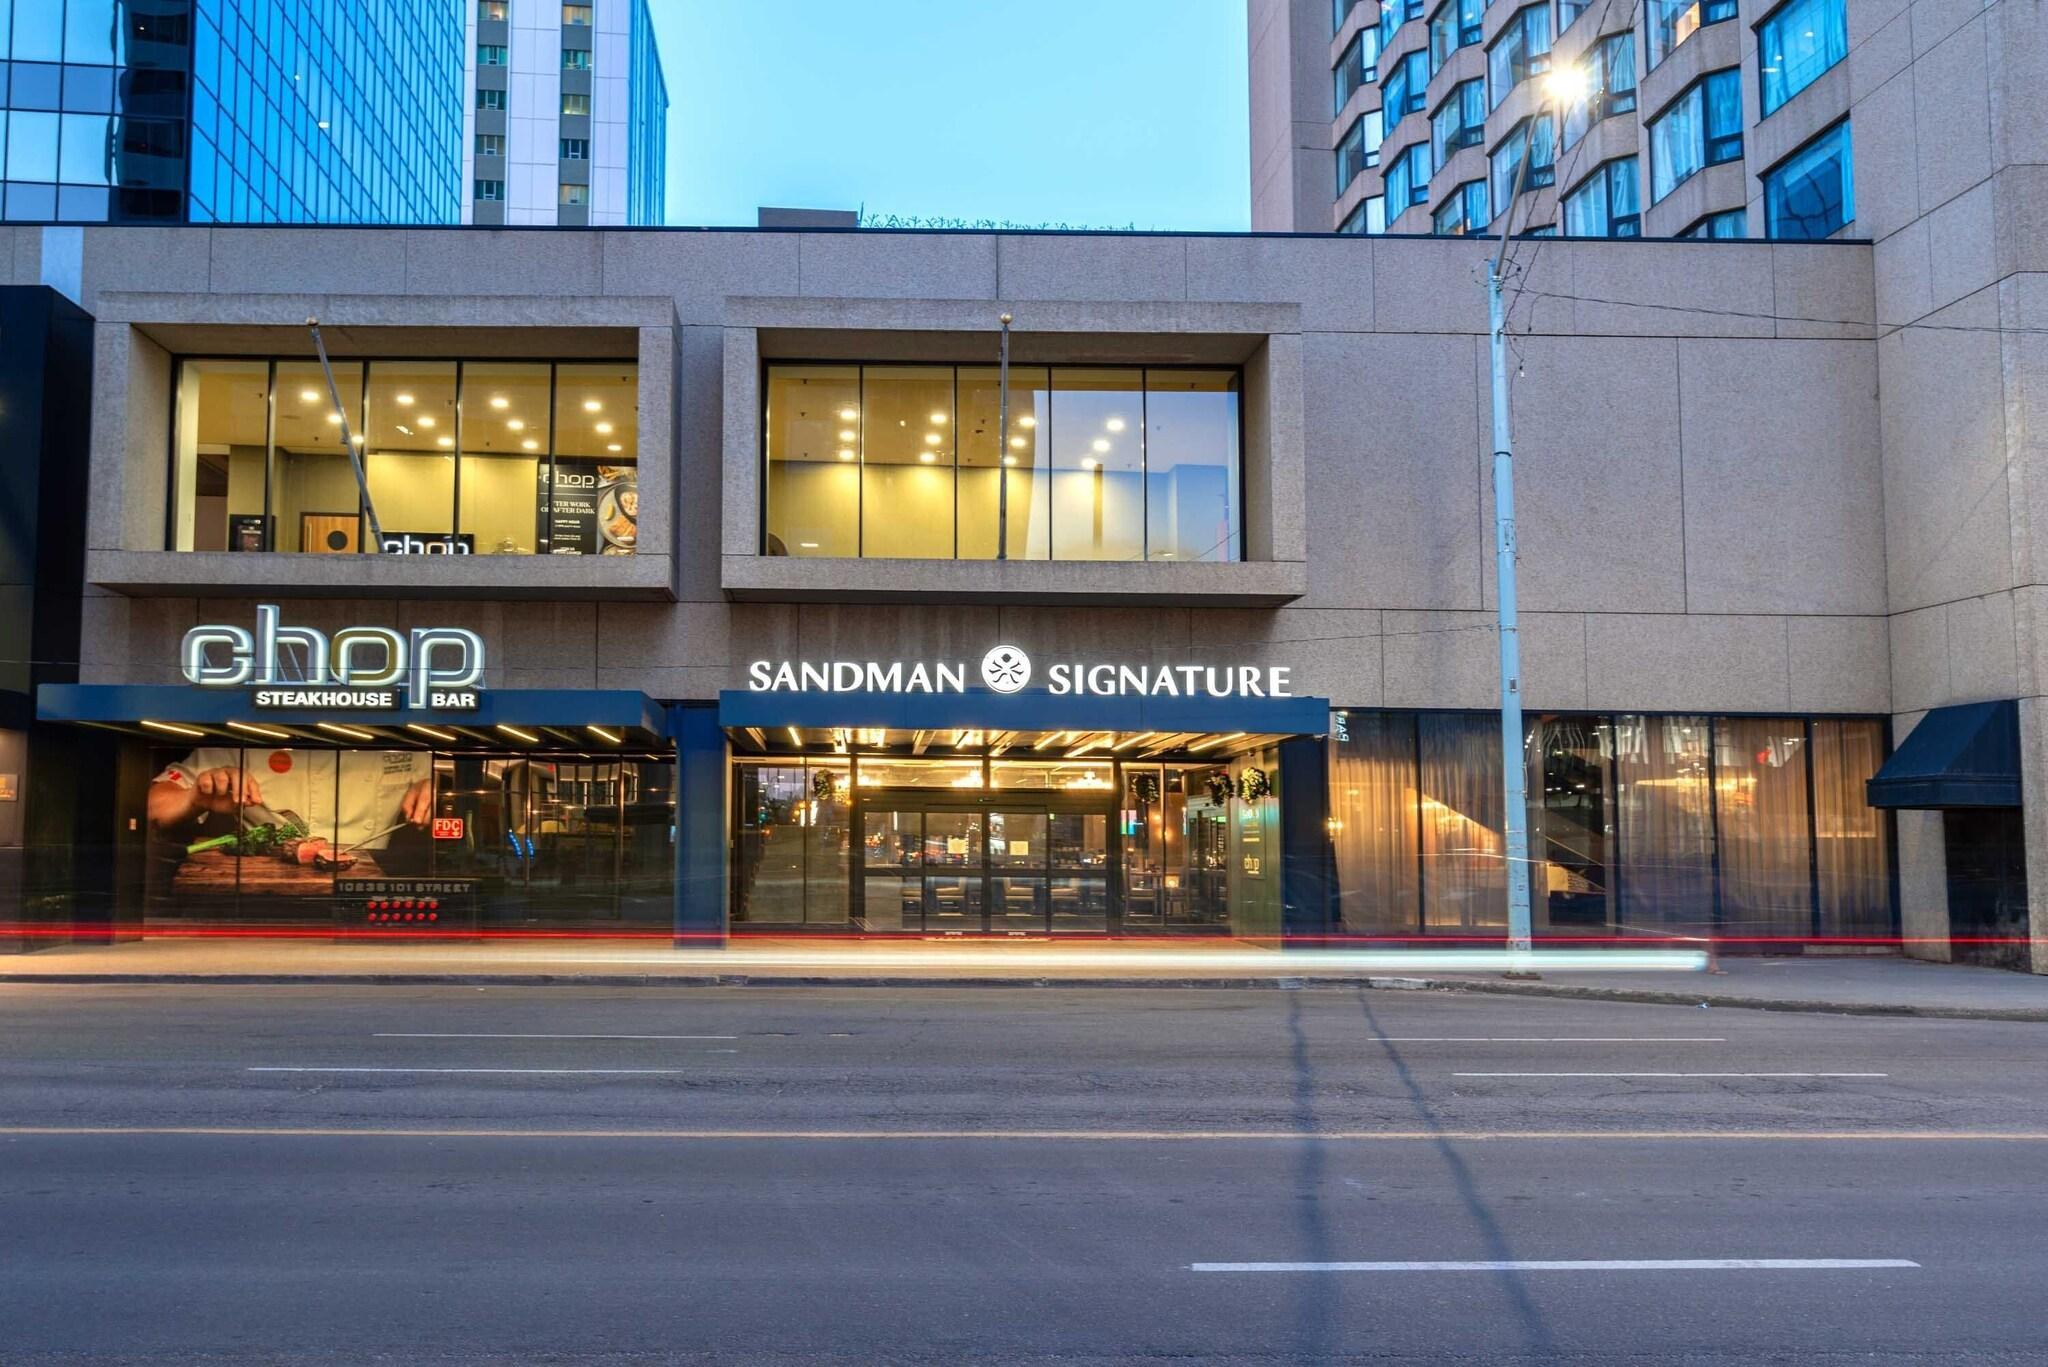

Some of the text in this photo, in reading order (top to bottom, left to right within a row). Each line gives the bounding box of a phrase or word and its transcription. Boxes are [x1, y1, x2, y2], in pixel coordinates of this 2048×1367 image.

[181, 604, 486, 709] chop
[748, 660, 1293, 697] SANDMAN SIGNATURE
[256, 691, 475, 706] STEAKHOUSE BAR
[435, 820, 460, 831] FDC
[390, 883, 411, 892] 101
[415, 883, 471, 893] STREET
